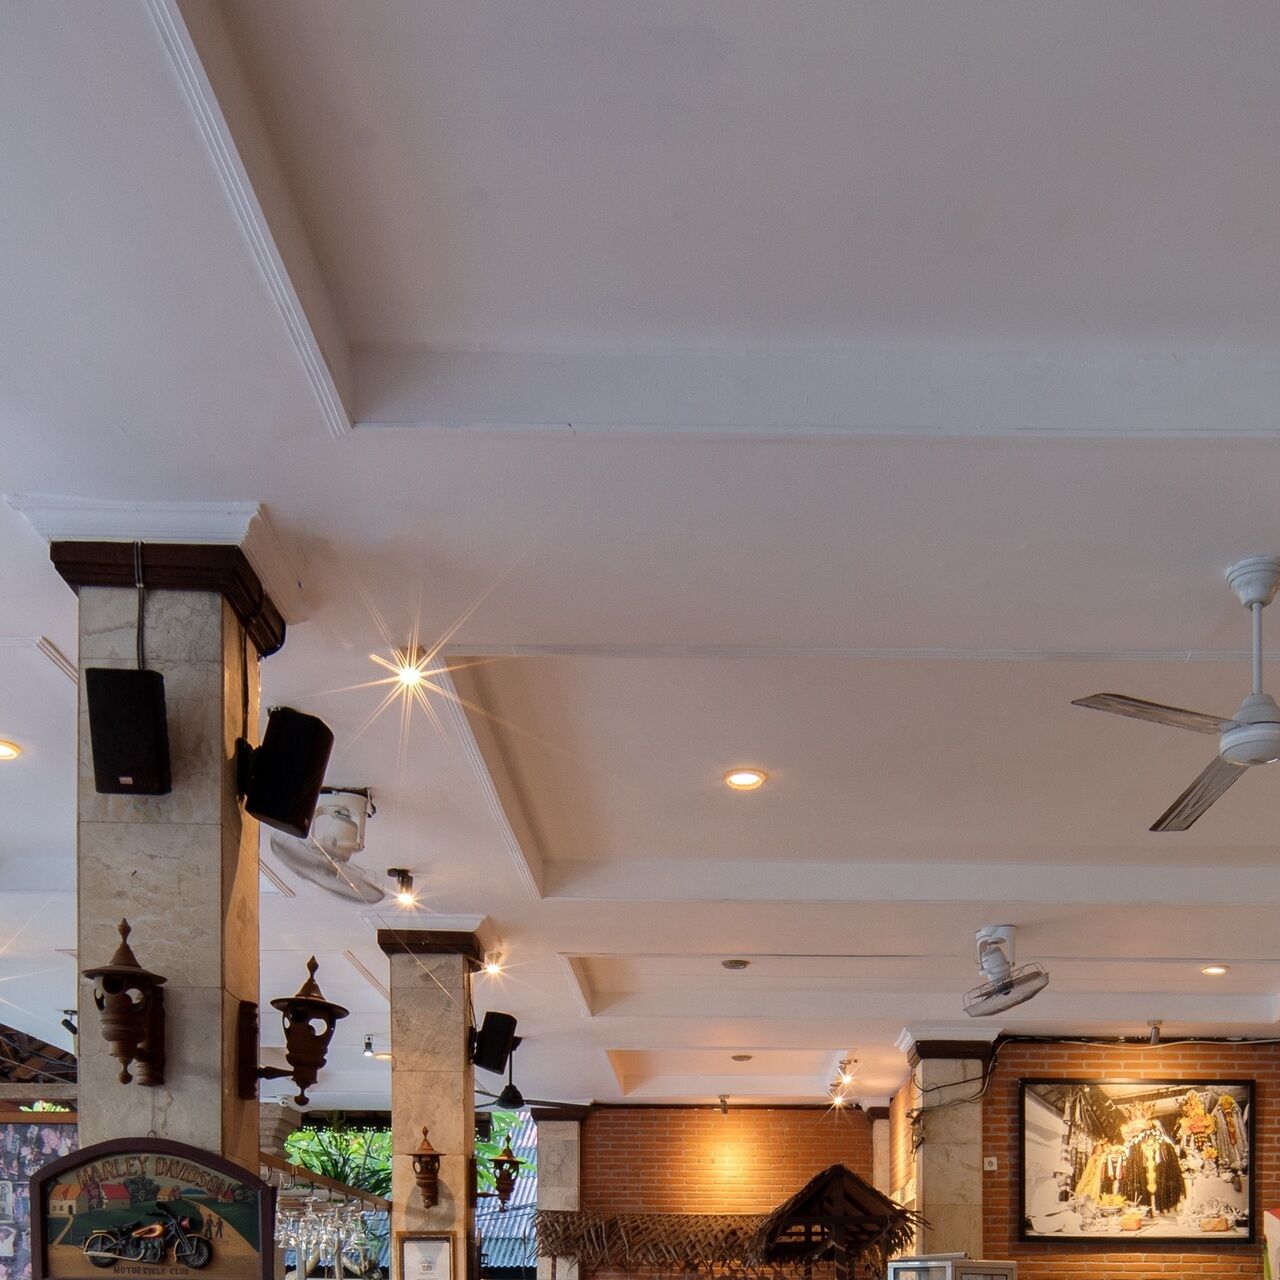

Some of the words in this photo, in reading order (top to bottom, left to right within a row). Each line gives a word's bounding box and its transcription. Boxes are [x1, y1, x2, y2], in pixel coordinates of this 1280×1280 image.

[76, 1155, 150, 1190] HARLEY
[154, 1156, 234, 1198] DAVIDSON
[169, 1266, 189, 1275] CLUB
